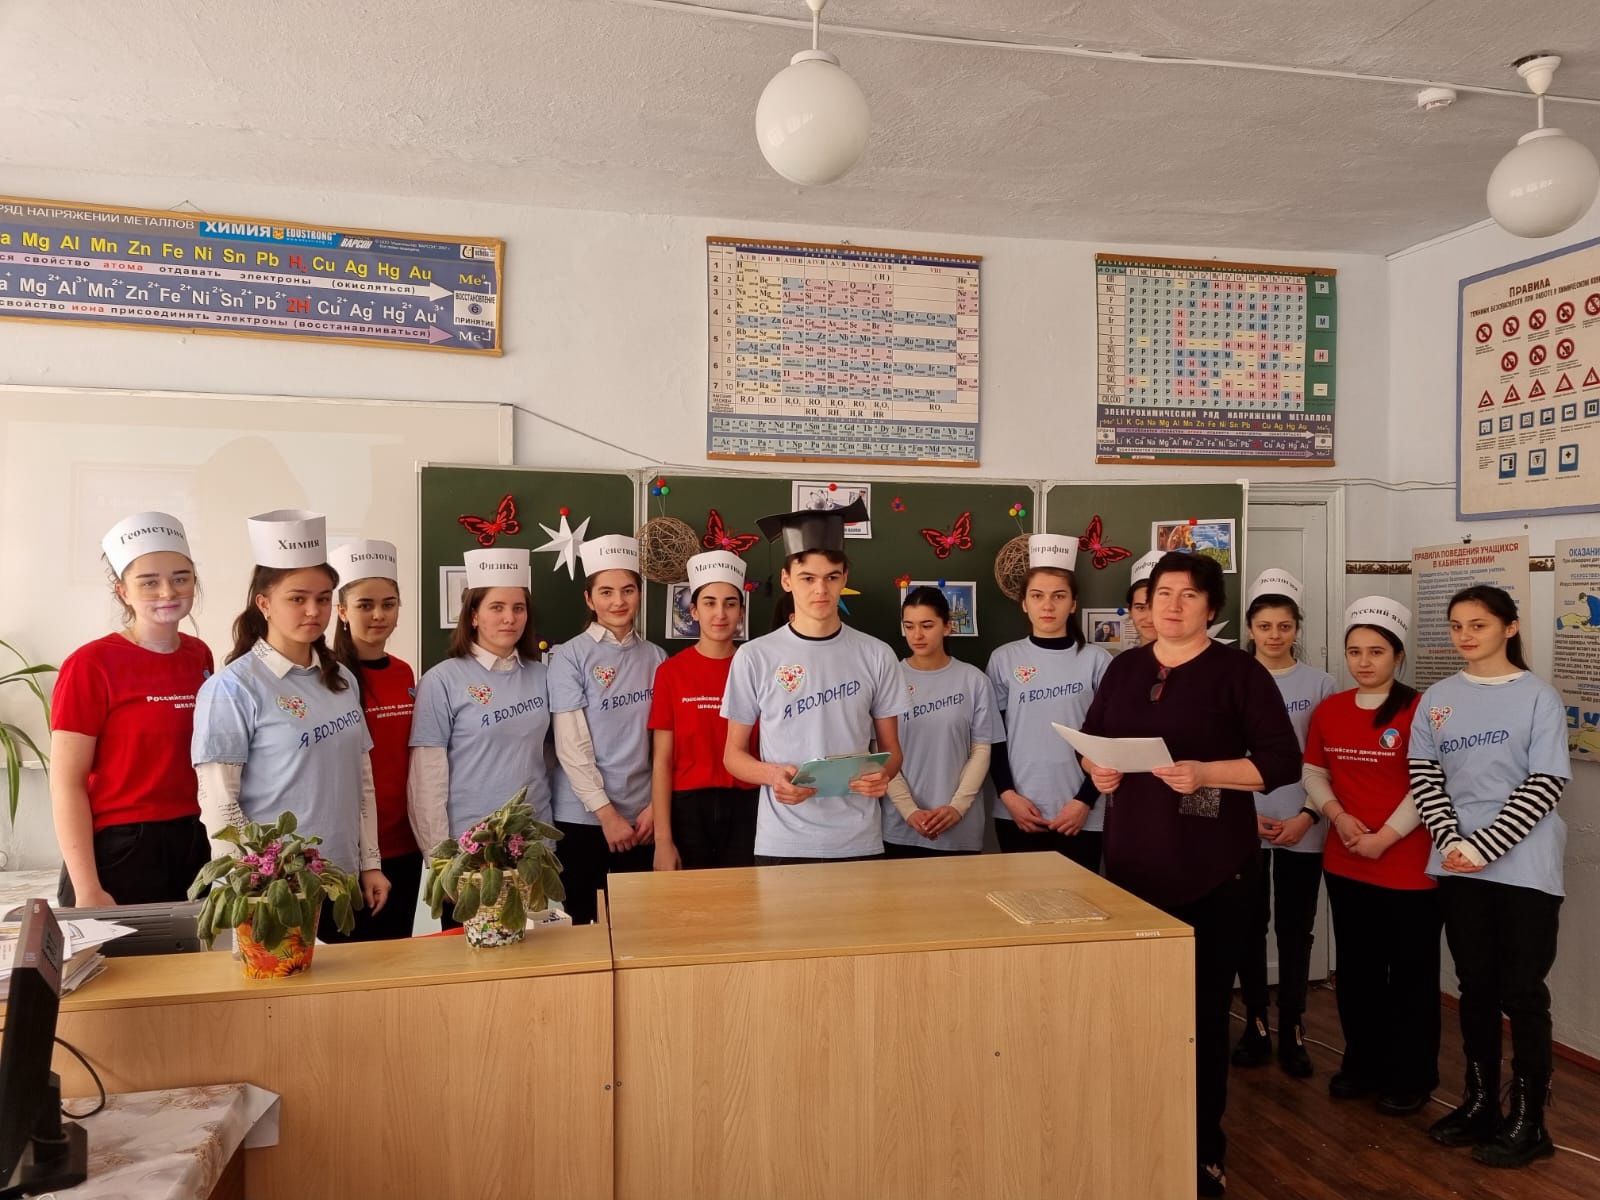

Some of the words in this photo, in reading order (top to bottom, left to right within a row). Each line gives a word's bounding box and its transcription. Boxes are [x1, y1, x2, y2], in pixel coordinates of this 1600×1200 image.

[205, 221, 271, 238] ХИМИЯ
[22, 231, 50, 252] Mg
[60, 235, 79, 250] Al
[90, 237, 118, 253] Mn
[127, 240, 151, 256] Zn
[161, 243, 184, 259] Fe
[194, 246, 213, 261] Ni
[223, 248, 246, 264] Sn
[256, 251, 280, 267] Pb
[312, 256, 335, 272] Cu
[344, 259, 368, 278] Ag
[378, 262, 400, 280] Hg
[409, 265, 432, 280] Au
[24, 256, 91, 267] свойство
[103, 262, 144, 271] атома
[159, 266, 222, 277] отдавать
[239, 272, 312, 285] электроны
[1509, 278, 1551, 298] ПРАВИЛА
[72, 304, 105, 313] иона
[111, 306, 209, 320] присоединять
[216, 314, 288, 326] электроны
[455, 316, 494, 327] ПРИНЯТИЕ
[278, 539, 320, 550] Химия
[1569, 547, 1600, 557] ОКАЗАНИ
[783, 704, 793, 720] Я
[797, 680, 861, 715] ВОЛОНТЕР
[1018, 692, 1026, 705] Я
[1029, 682, 1084, 702] ВОЛОНТЕР
[481, 714, 490, 728] Я
[494, 696, 544, 723] ВОЛОНТЕР
[600, 698, 609, 711] Я
[913, 693, 964, 718] ВОЛОНТЕР
[1287, 700, 1311, 713] НТЕР
[298, 732, 309, 749] Я
